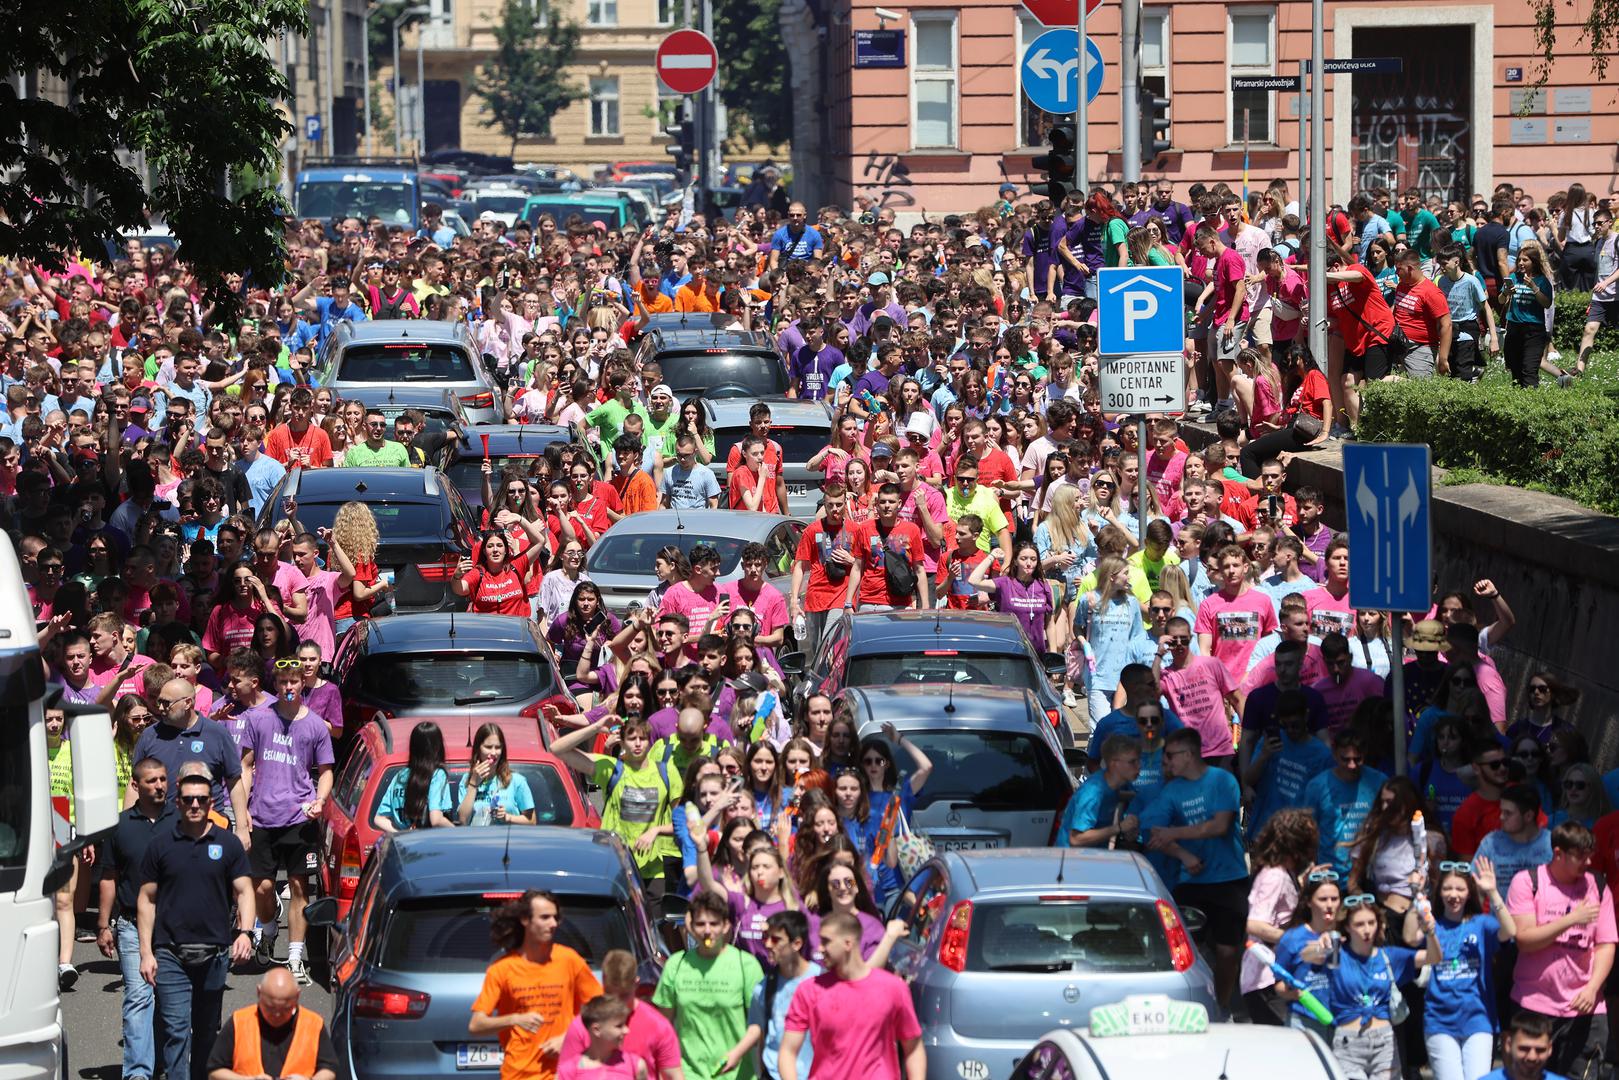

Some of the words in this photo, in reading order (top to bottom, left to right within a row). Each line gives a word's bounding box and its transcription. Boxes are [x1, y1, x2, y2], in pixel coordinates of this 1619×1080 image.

[1324, 61, 1359, 70] anovićeva
[1265, 79, 1295, 88] podvožnjak
[308, 119, 319, 137] P
[1124, 291, 1158, 341] P
[1106, 361, 1176, 374] IMPORTANNE
[1120, 377, 1162, 389] CENTAR
[1108, 393, 1133, 407] 300
[1140, 398, 1150, 407] m
[1133, 1012, 1165, 1024] EKO
[470, 1046, 488, 1062] ZG
[962, 1060, 984, 1078] HR
